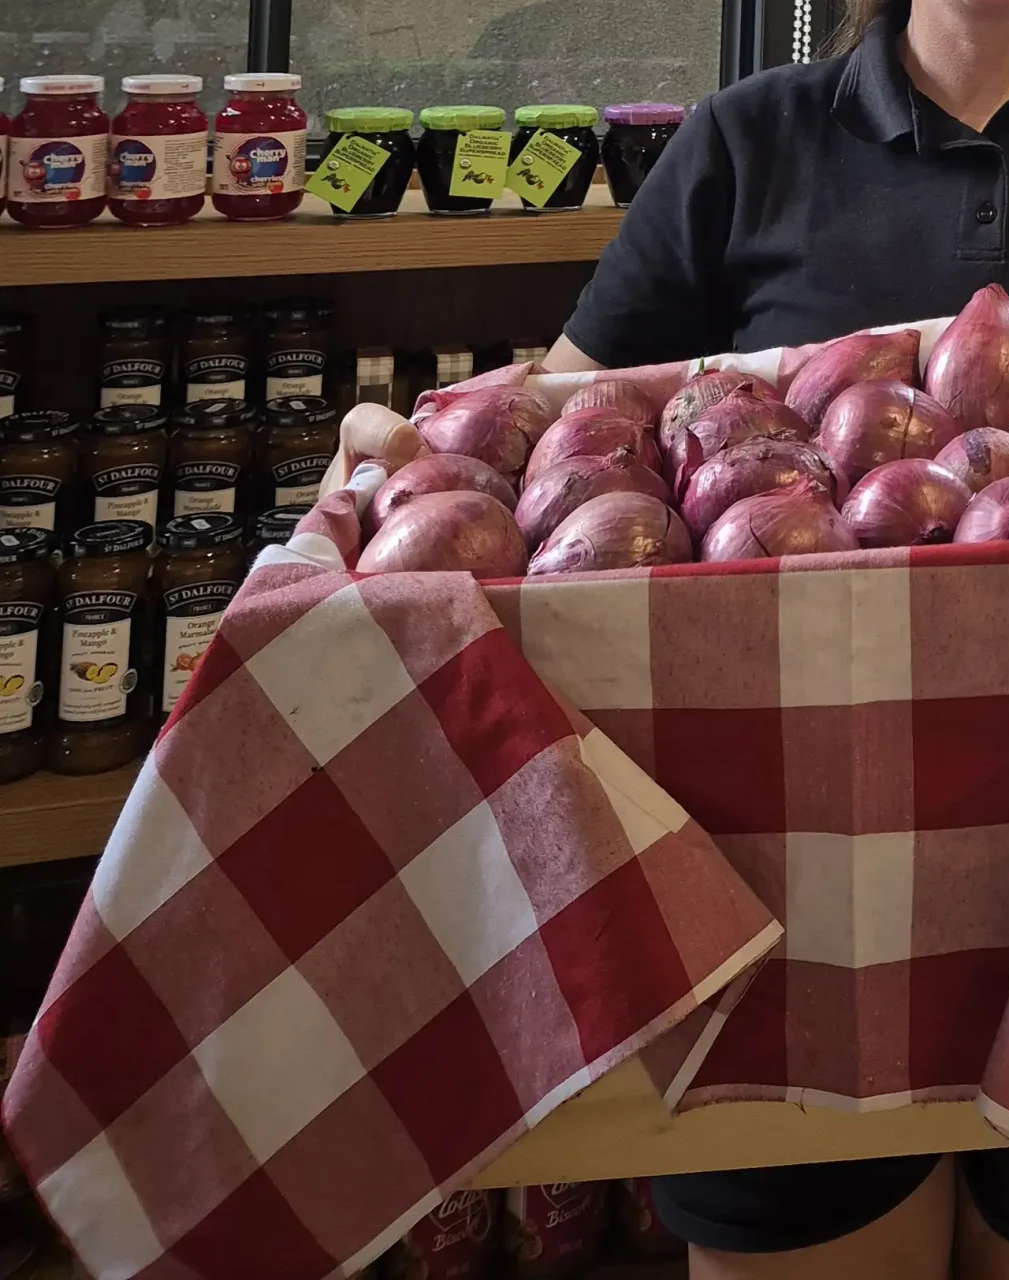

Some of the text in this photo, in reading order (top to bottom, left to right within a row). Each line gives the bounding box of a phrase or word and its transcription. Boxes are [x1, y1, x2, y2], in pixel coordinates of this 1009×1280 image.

[200, 358, 246, 369] DALFOUR
[278, 354, 323, 365] DALFOUR
[290, 458, 332, 471] DALFOU
[185, 465, 235, 477] DALFOUR
[2, 479, 55, 491] DALFOUR
[296, 490, 319, 499] Orang
[181, 584, 233, 600] DALFOUR
[76, 595, 131, 607] DALFOUR
[0, 606, 39, 618] LFOUR
[187, 620, 216, 630] Orange
[72, 629, 110, 639] Pineapple
[180, 627, 217, 639] Marmala
[80, 639, 107, 648] Mango
